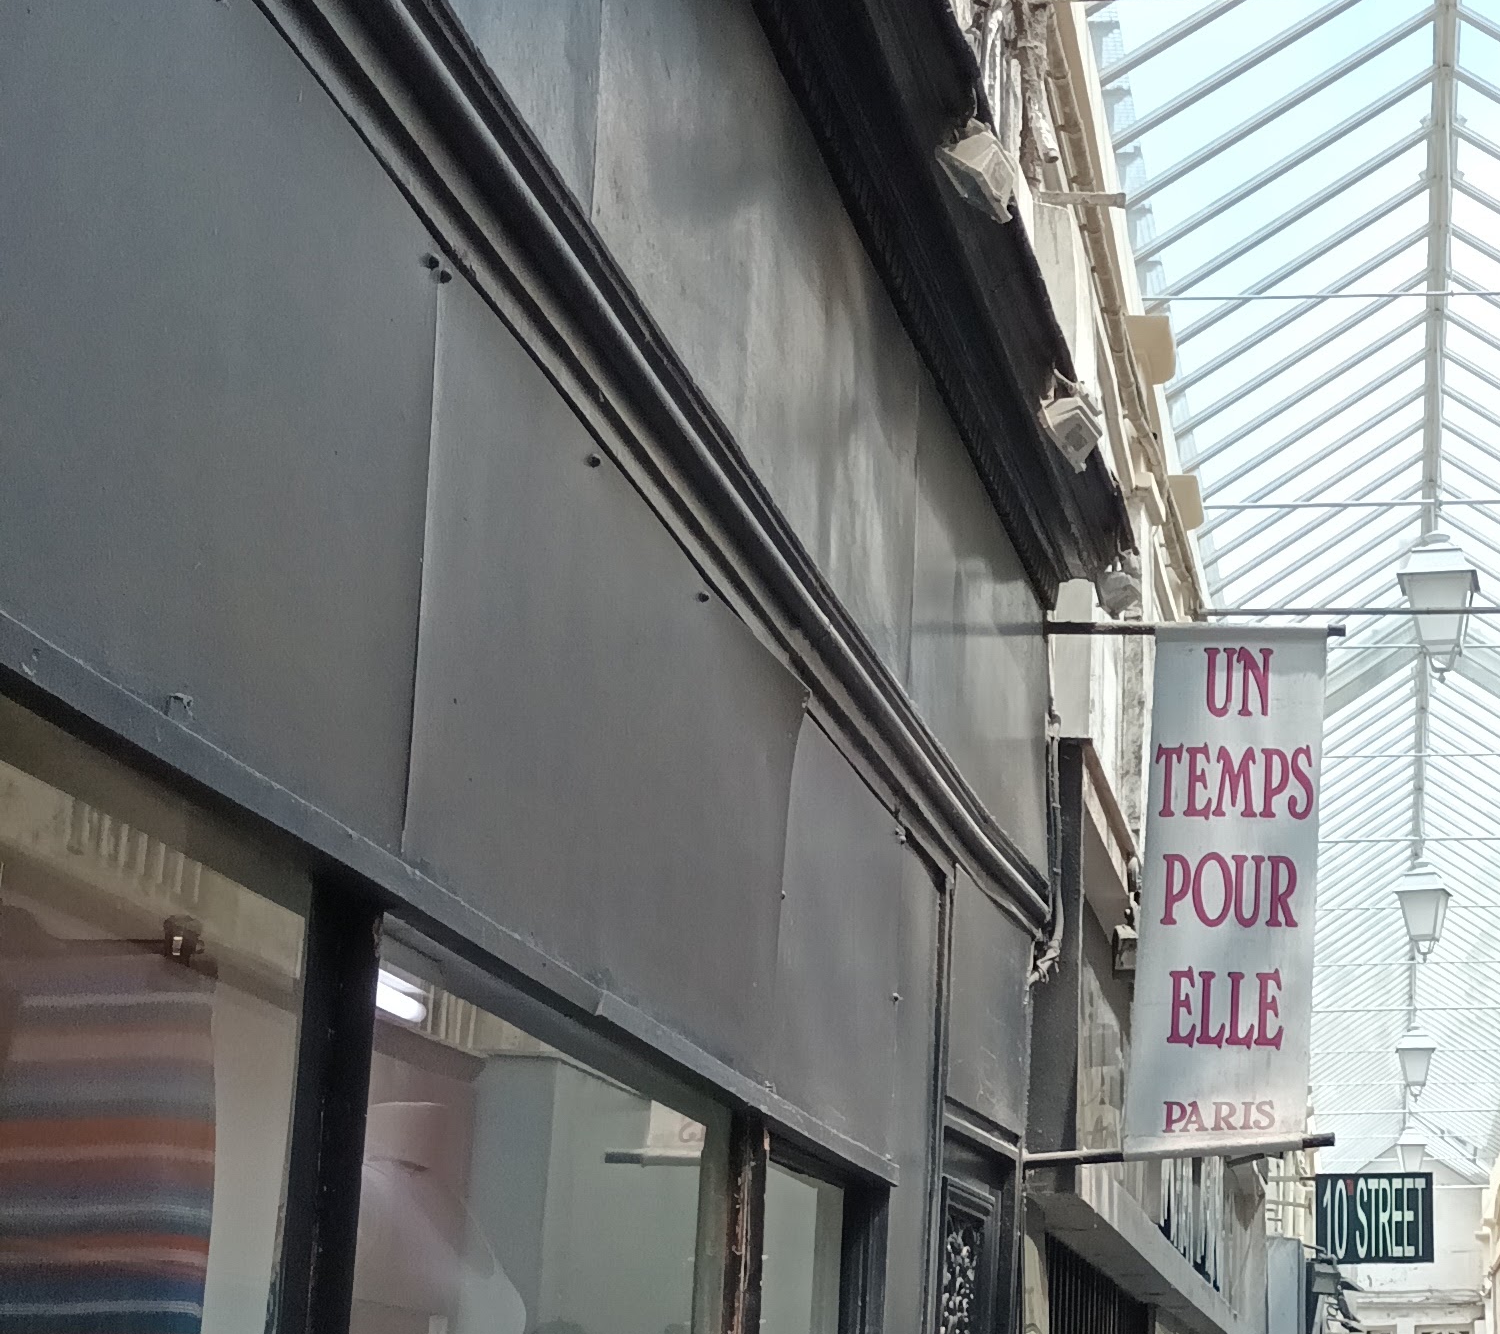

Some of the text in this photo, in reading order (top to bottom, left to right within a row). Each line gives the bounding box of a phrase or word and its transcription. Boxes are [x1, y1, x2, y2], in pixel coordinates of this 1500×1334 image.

[1204, 647, 1273, 717] UN
[1155, 743, 1314, 821] TEMPS
[1160, 852, 1298, 927] POUR
[1166, 966, 1284, 1051] ELLE
[1162, 1099, 1276, 1135] PARIS
[1355, 1177, 1426, 1259] STREET
